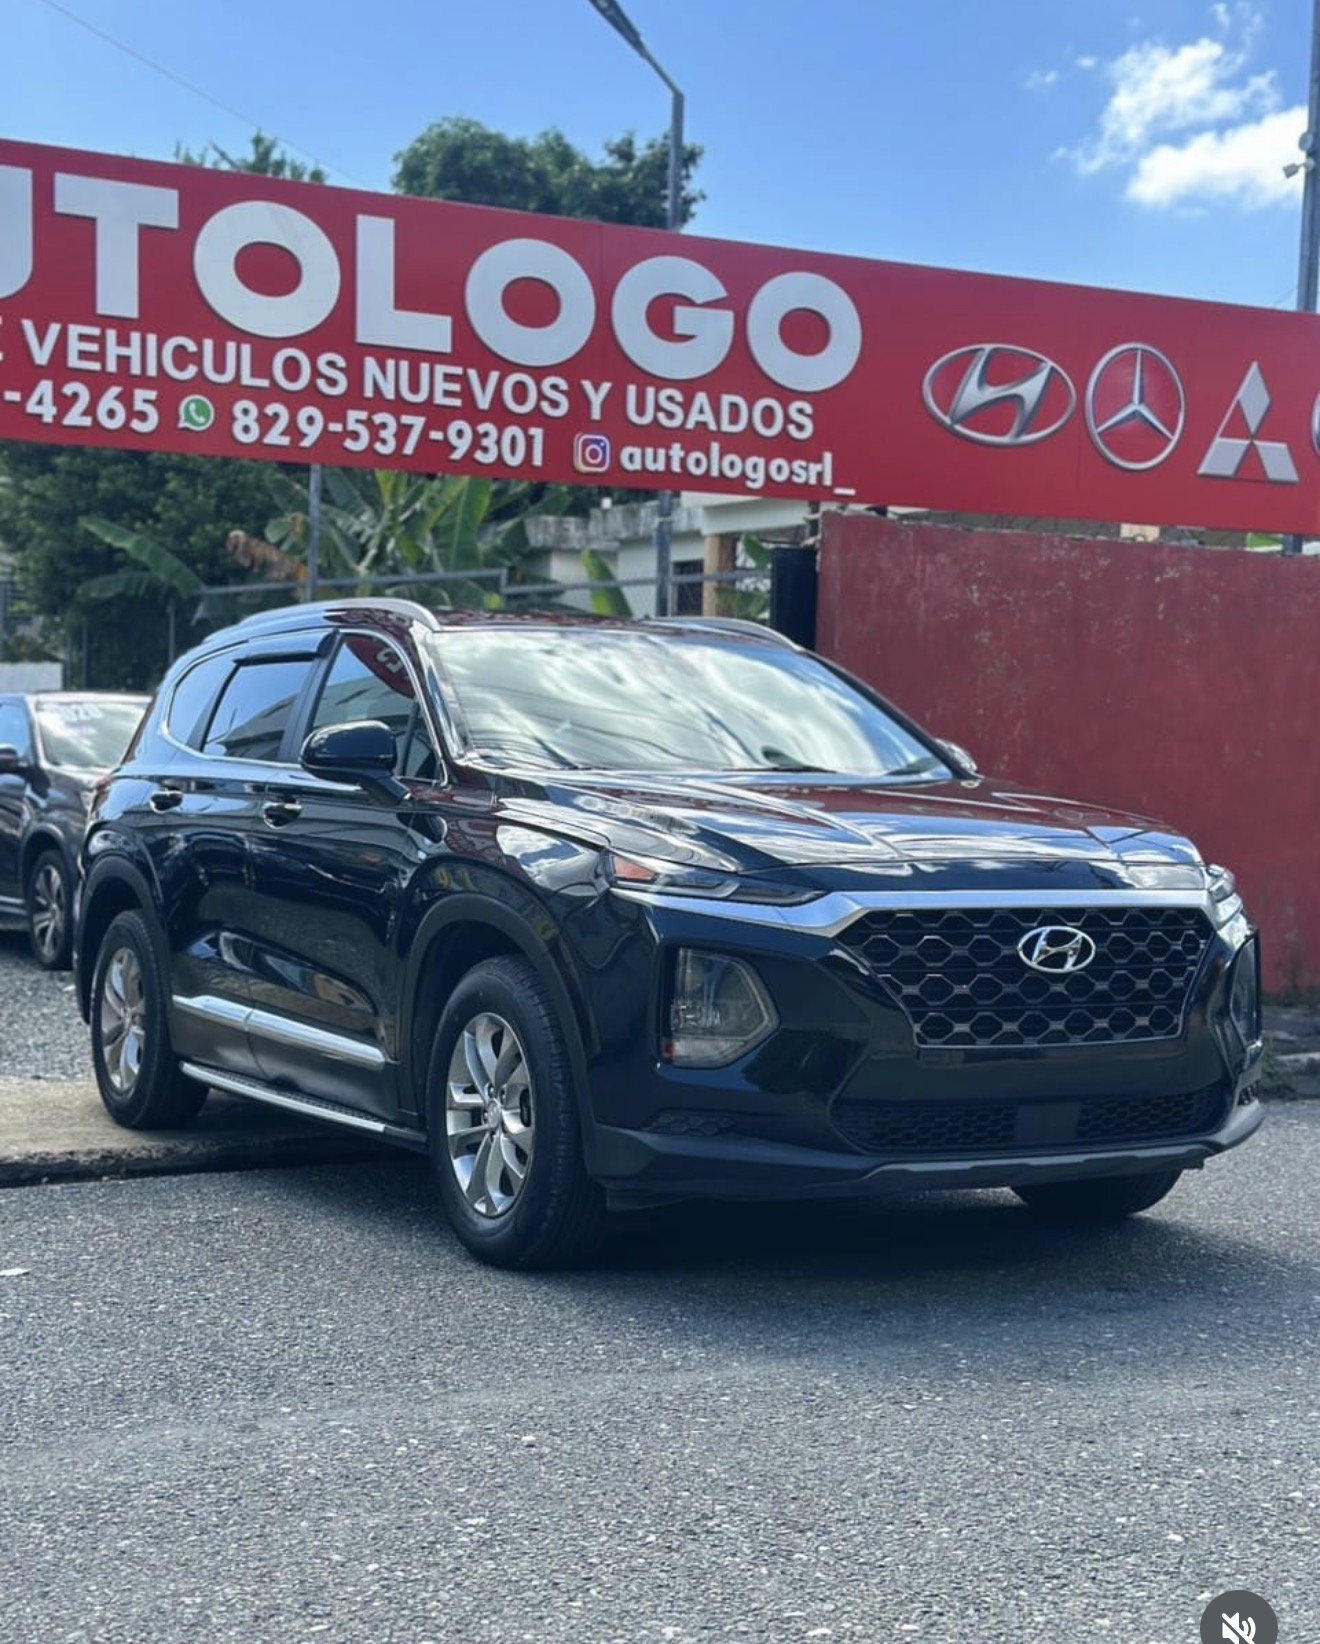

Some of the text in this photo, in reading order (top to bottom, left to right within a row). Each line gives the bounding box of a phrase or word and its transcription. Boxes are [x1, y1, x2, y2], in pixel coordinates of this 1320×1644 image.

[0, 166, 862, 393] TOLOGO
[21, 319, 348, 397] VEHICULOS
[363, 356, 570, 418] NUEVOS
[580, 380, 612, 420] Y
[626, 384, 815, 440] USADOS
[231, 399, 544, 467] 829-537-9301
[619, 440, 856, 496] autologosrl_
